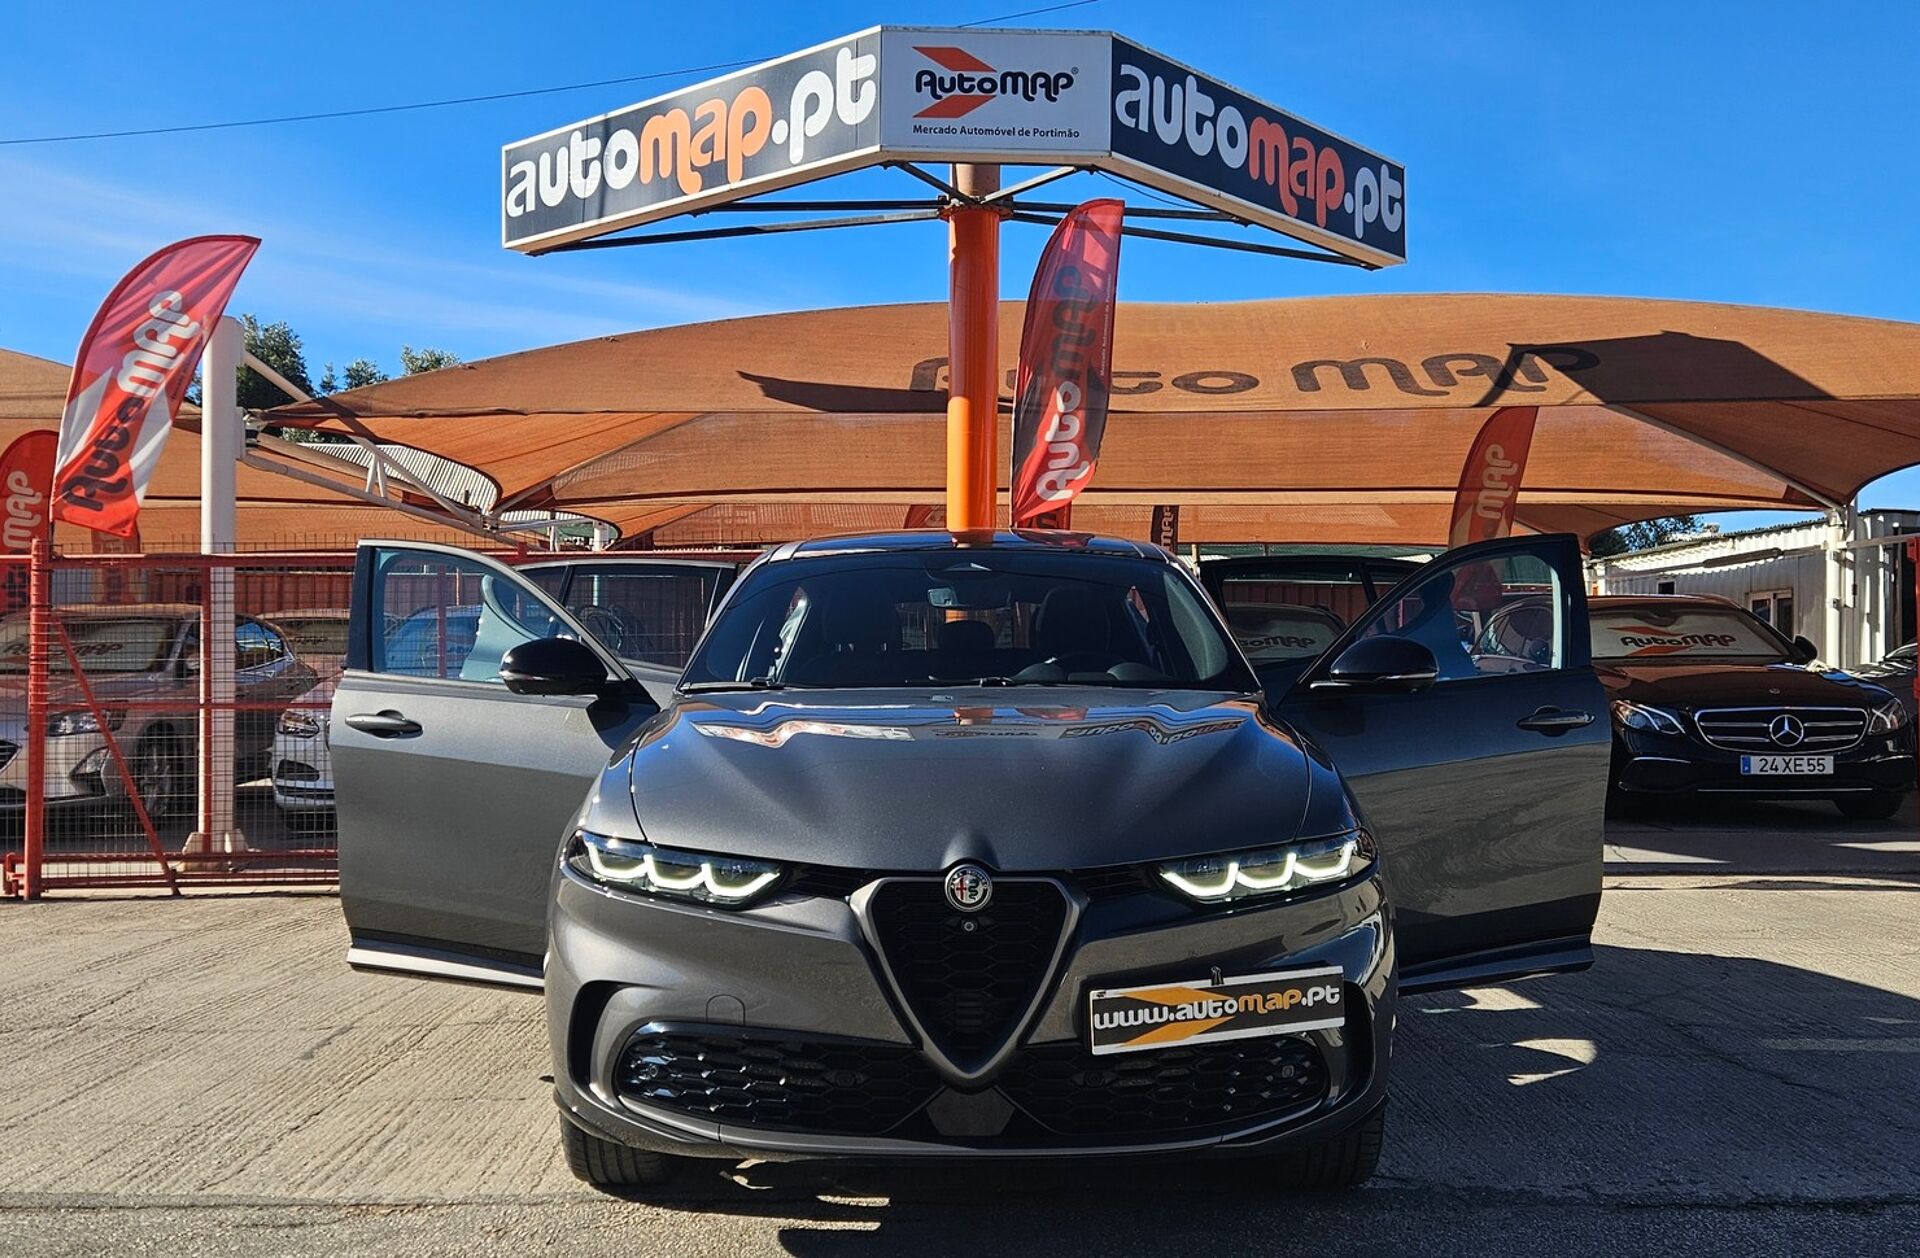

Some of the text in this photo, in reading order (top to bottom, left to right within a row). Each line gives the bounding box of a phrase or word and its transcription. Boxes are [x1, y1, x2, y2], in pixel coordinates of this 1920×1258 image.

[506, 46, 877, 218] automap.pt
[912, 124, 1080, 138] Mercado Automóvel de Portimão
[1115, 64, 1402, 239] automap.pt
[62, 290, 200, 511] AutoMAP
[1620, 633, 1736, 648] AutoMAP
[1093, 985, 1340, 1030] www.automap.pt
